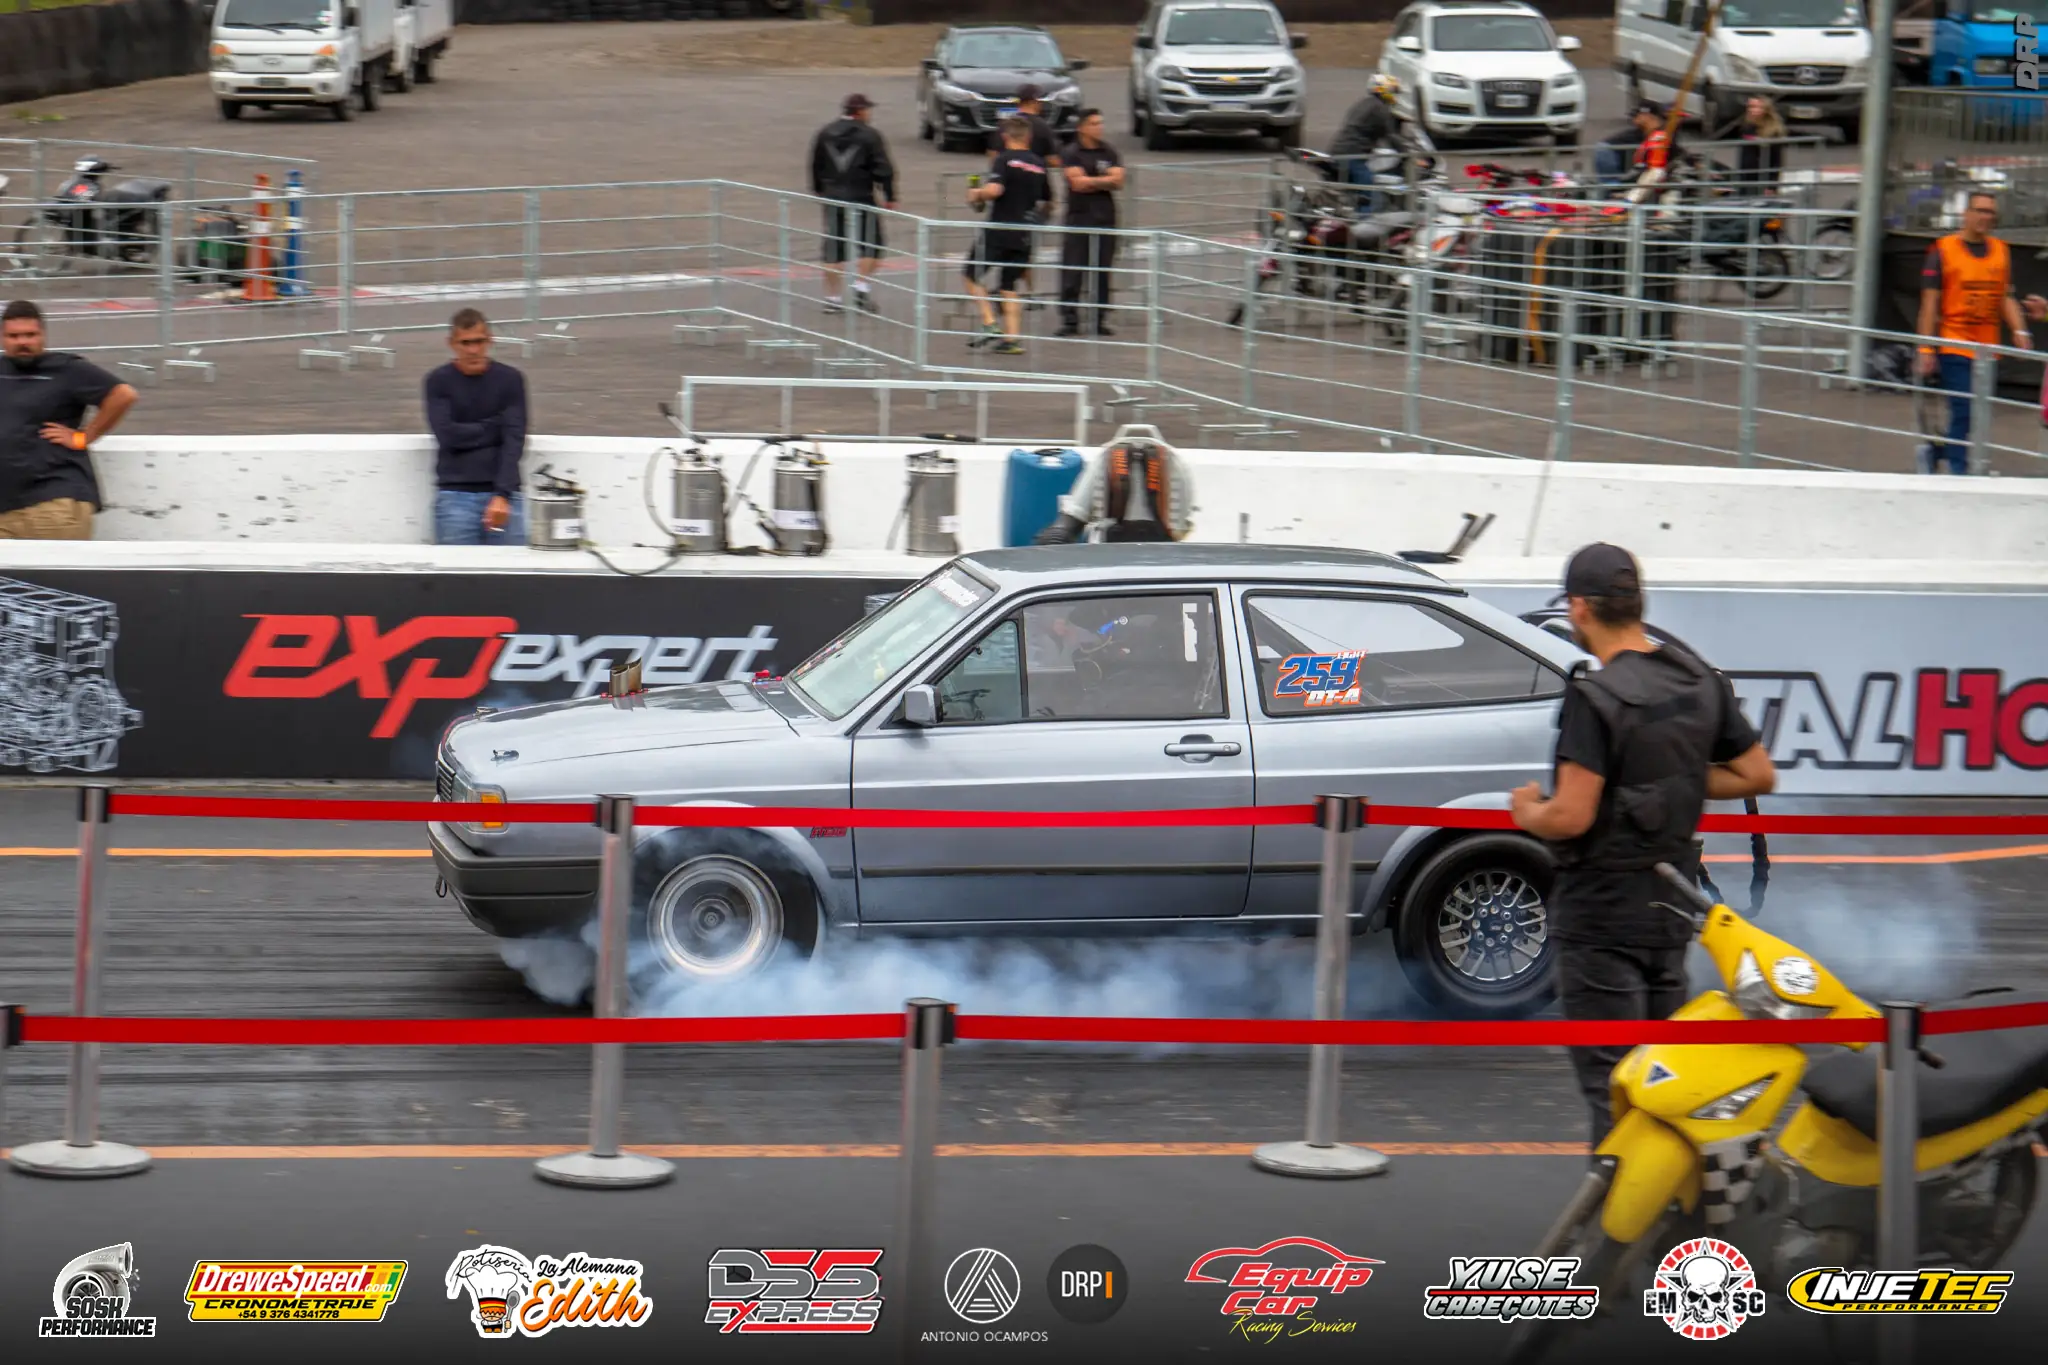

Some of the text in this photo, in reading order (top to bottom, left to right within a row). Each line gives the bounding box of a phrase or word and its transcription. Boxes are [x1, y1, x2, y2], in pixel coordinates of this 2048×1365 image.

[223, 614, 778, 738] exp expert
[1275, 655, 1360, 695] 259
